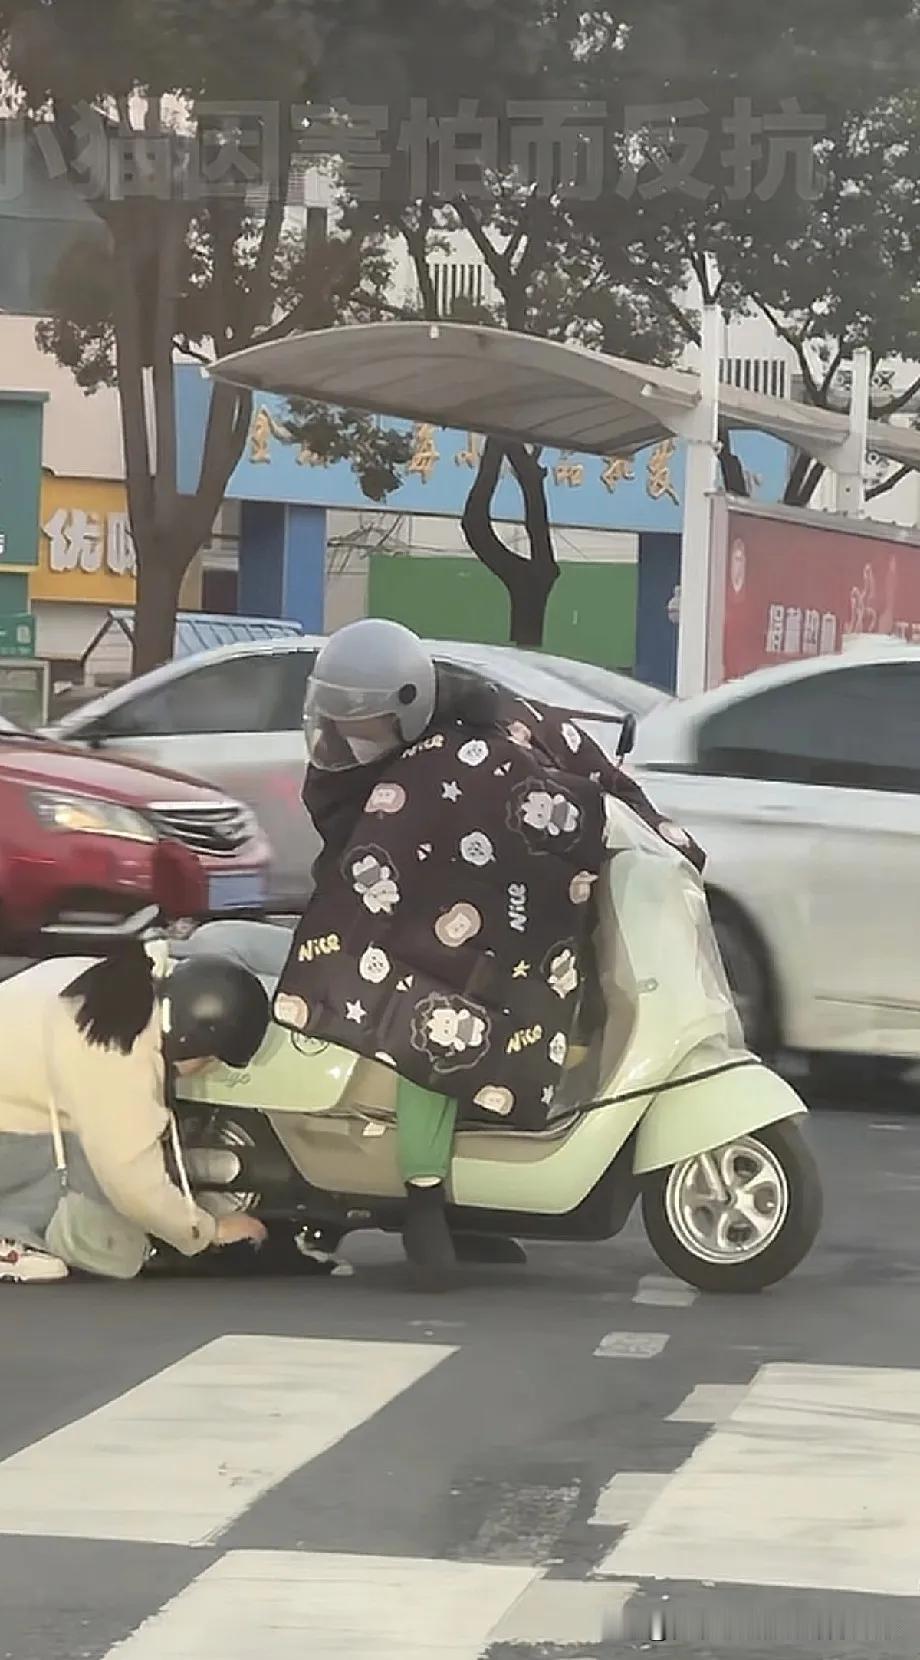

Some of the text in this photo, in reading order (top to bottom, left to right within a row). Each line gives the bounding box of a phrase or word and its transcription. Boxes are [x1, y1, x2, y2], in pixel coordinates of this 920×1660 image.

[508, 882, 528, 933] Nice
[297, 933, 342, 963] Nice
[505, 1024, 544, 1055] Nice
